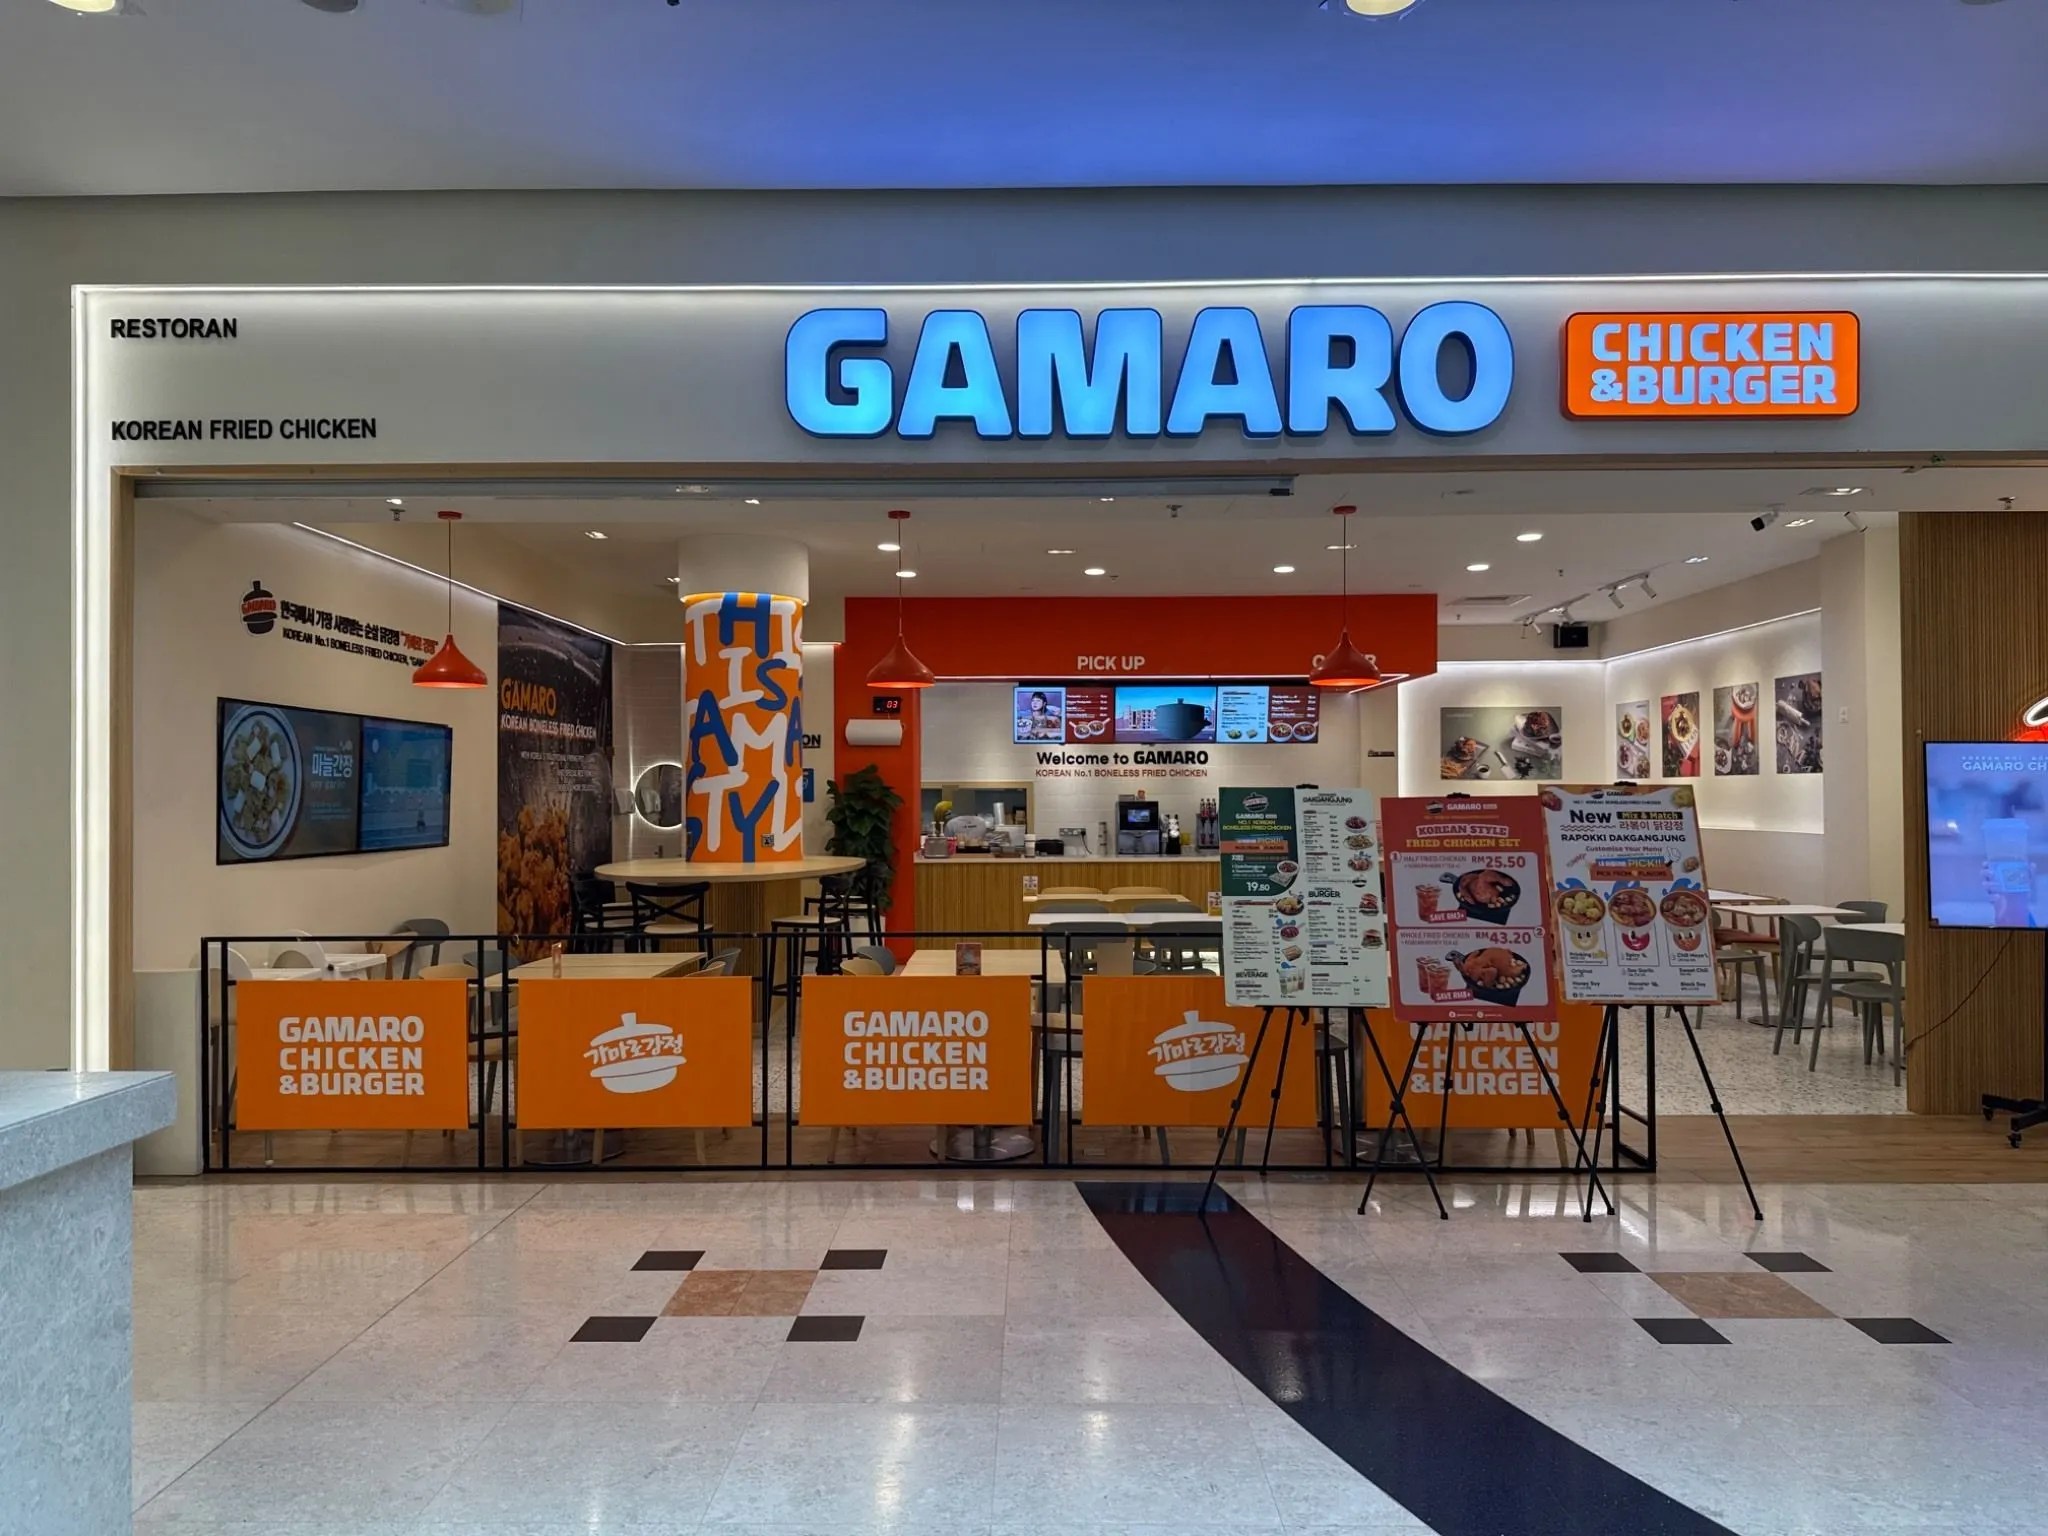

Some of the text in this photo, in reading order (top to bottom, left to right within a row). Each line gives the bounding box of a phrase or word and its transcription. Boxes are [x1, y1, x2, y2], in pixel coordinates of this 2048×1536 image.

[111, 318, 237, 338] RESTORAN
[1592, 323, 1833, 362] CHICKEN
[786, 302, 1515, 439] GAMARO
[1591, 365, 1838, 405] &BURGER
[112, 418, 377, 441] KOREAN FRIED CHICKEN
[283, 627, 313, 645] KOREAN
[330, 639, 364, 655] BONELESS
[365, 645, 382, 659] FRIED
[1077, 655, 1146, 671] PICK UP
[501, 677, 557, 717] GAMARO
[886, 700, 899, 709] 03
[501, 714, 597, 740] KOREAN BONELESS FRIED CHICKEN
[311, 753, 353, 777] 마늘간장
[1036, 751, 1209, 765] Welcome to GAMARO
[1962, 761, 2024, 771] GAMARO
[1035, 769, 1208, 778] KOREAN No.1 BONELESS FRIED CHICKEN
[1570, 810, 1613, 824] New
[1619, 821, 1684, 831] 라볶이 닭강정
[1622, 812, 1639, 820] Mix
[1650, 812, 1679, 820] Match
[1418, 825, 1507, 836] KOREAN STYLE
[1561, 834, 1686, 843] RAPOKKI DAKGANGJUNG
[1406, 838, 1521, 848] FRIED CHICKEN SET
[1429, 912, 1446, 922] SAVE
[1436, 991, 1452, 1001] SAVE
[279, 1016, 425, 1043] GAMARO
[843, 1010, 989, 1038] GAMARO
[280, 1047, 423, 1070] CHICKEN
[584, 1034, 684, 1065] 가마로강정
[843, 1042, 987, 1065] CHICKEN
[1147, 1032, 1247, 1063] 가마로강정
[1412, 1046, 1559, 1070] CHICKEN
[279, 1073, 425, 1096] &BURGER
[842, 1067, 989, 1091] &BURGER
[1410, 1072, 1561, 1096] &BURGER
